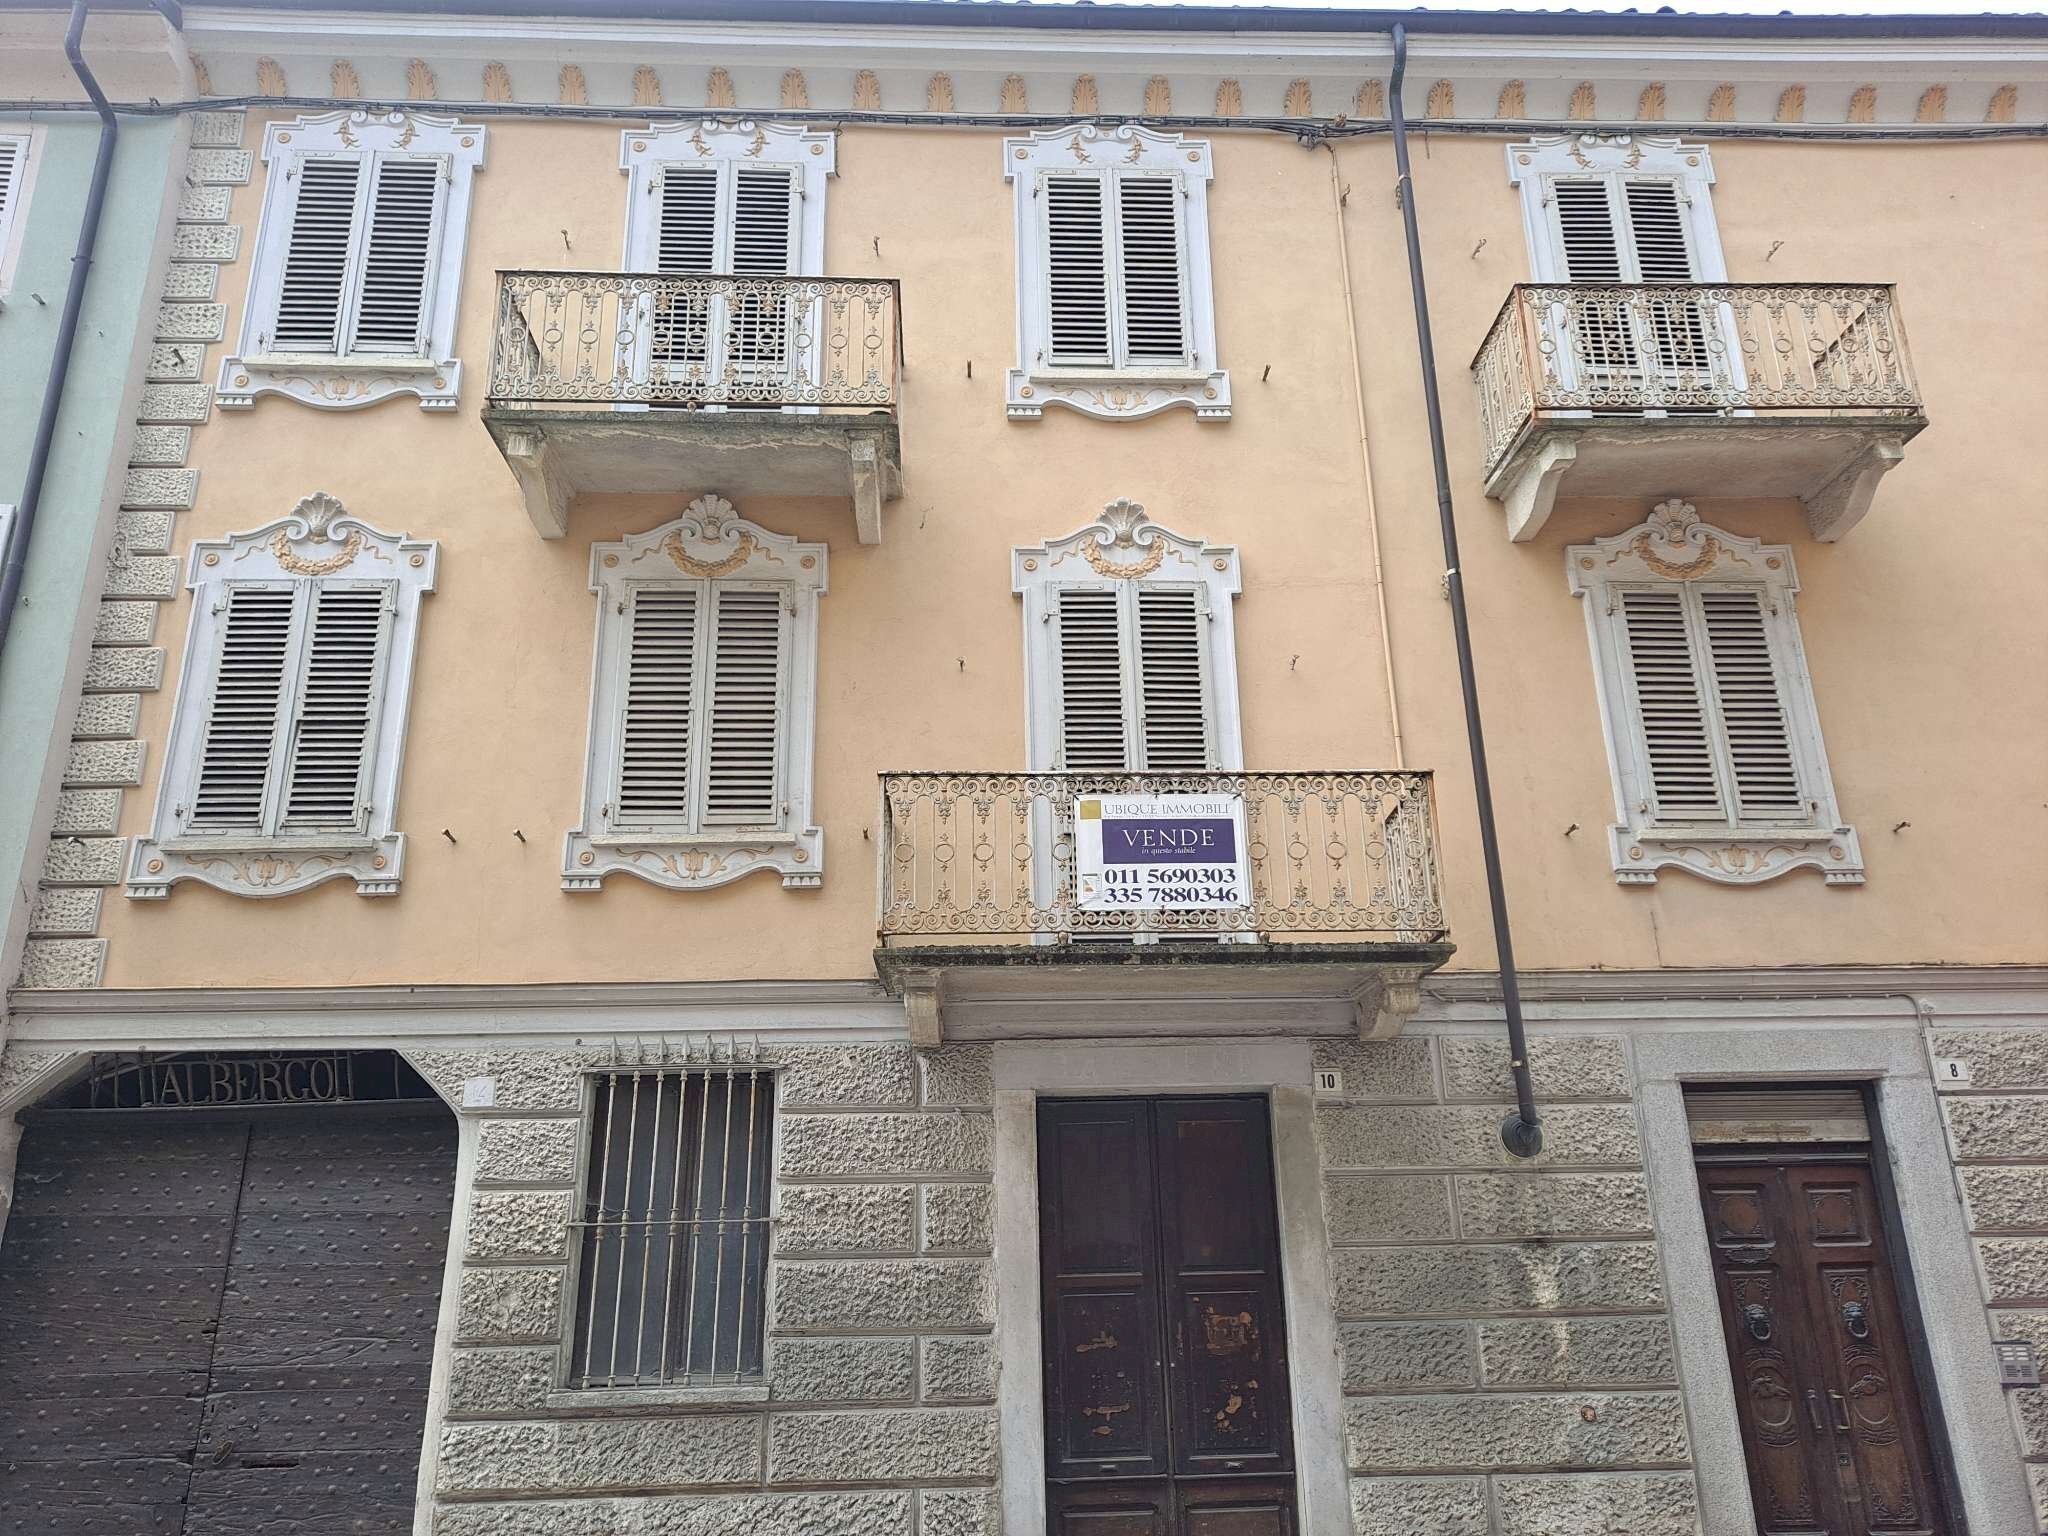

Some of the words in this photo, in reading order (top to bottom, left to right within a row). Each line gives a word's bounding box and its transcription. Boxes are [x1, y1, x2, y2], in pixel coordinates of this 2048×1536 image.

[1104, 804, 1157, 815] UBIQUE
[1162, 803, 1229, 814] IMMOBILI
[1121, 828, 1215, 847] VENDE
[1151, 848, 1173, 856] questo
[1174, 846, 1196, 854] stabile
[1104, 869, 1138, 884] 011
[1147, 868, 1236, 884] 5690303
[1104, 888, 1142, 903] 335
[1148, 887, 1238, 903] 7880346
[1950, 1063, 1959, 1077] 8
[160, 1058, 335, 1105] ALBERGO
[1320, 1073, 1335, 1089] 10
